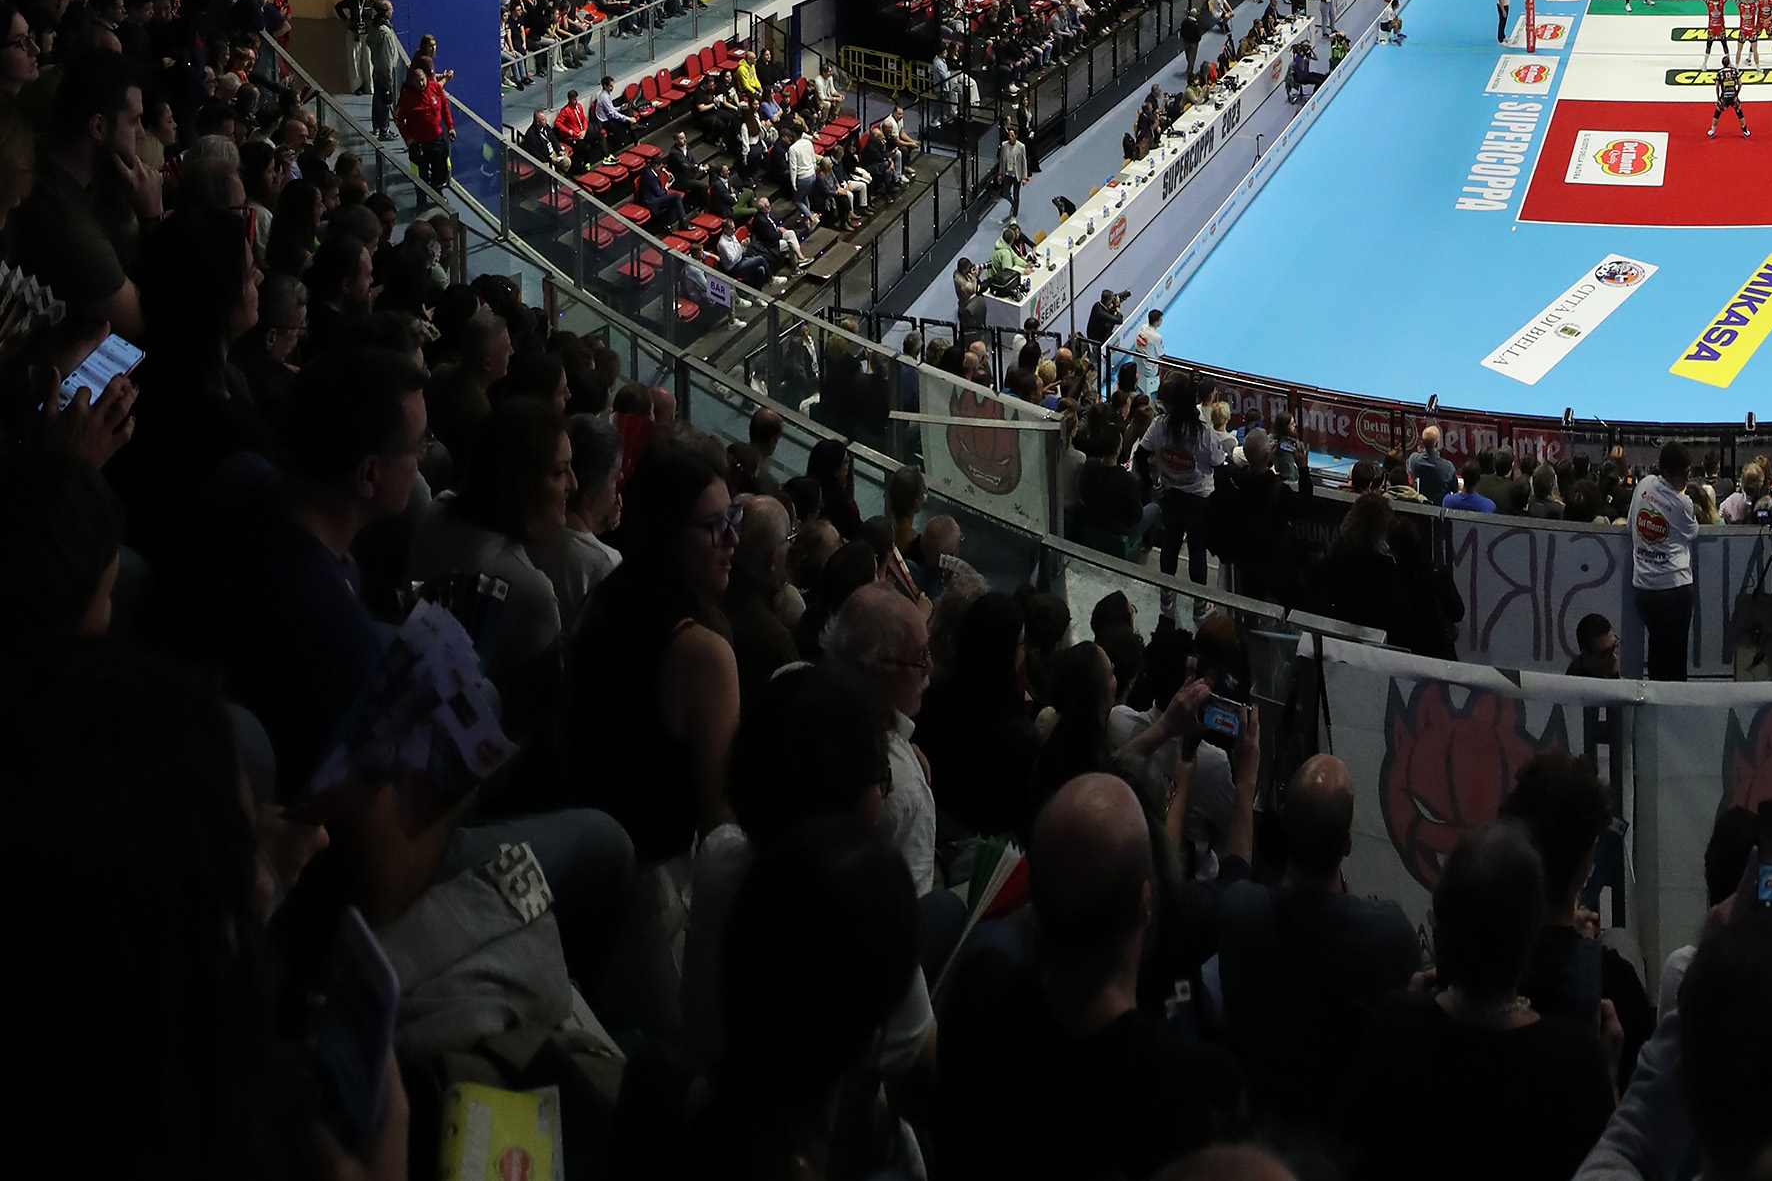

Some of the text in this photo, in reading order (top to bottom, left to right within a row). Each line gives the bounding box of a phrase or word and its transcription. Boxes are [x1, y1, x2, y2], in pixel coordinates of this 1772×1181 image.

[1162, 98, 1242, 201] SUPERCOPPA 2023
[1454, 100, 1544, 211] SUPERCOPPA
[1618, 141, 1638, 174] Del Monte
[711, 281, 726, 295] BAR
[1041, 298, 1061, 325] SERIE
[1492, 283, 1596, 366] CITTÀ DI BIELLA
[1225, 387, 1265, 424] Del
[1364, 419, 1379, 431] Del
[1472, 429, 1562, 465] Mnte
[1638, 517, 1668, 534] Del Monte
